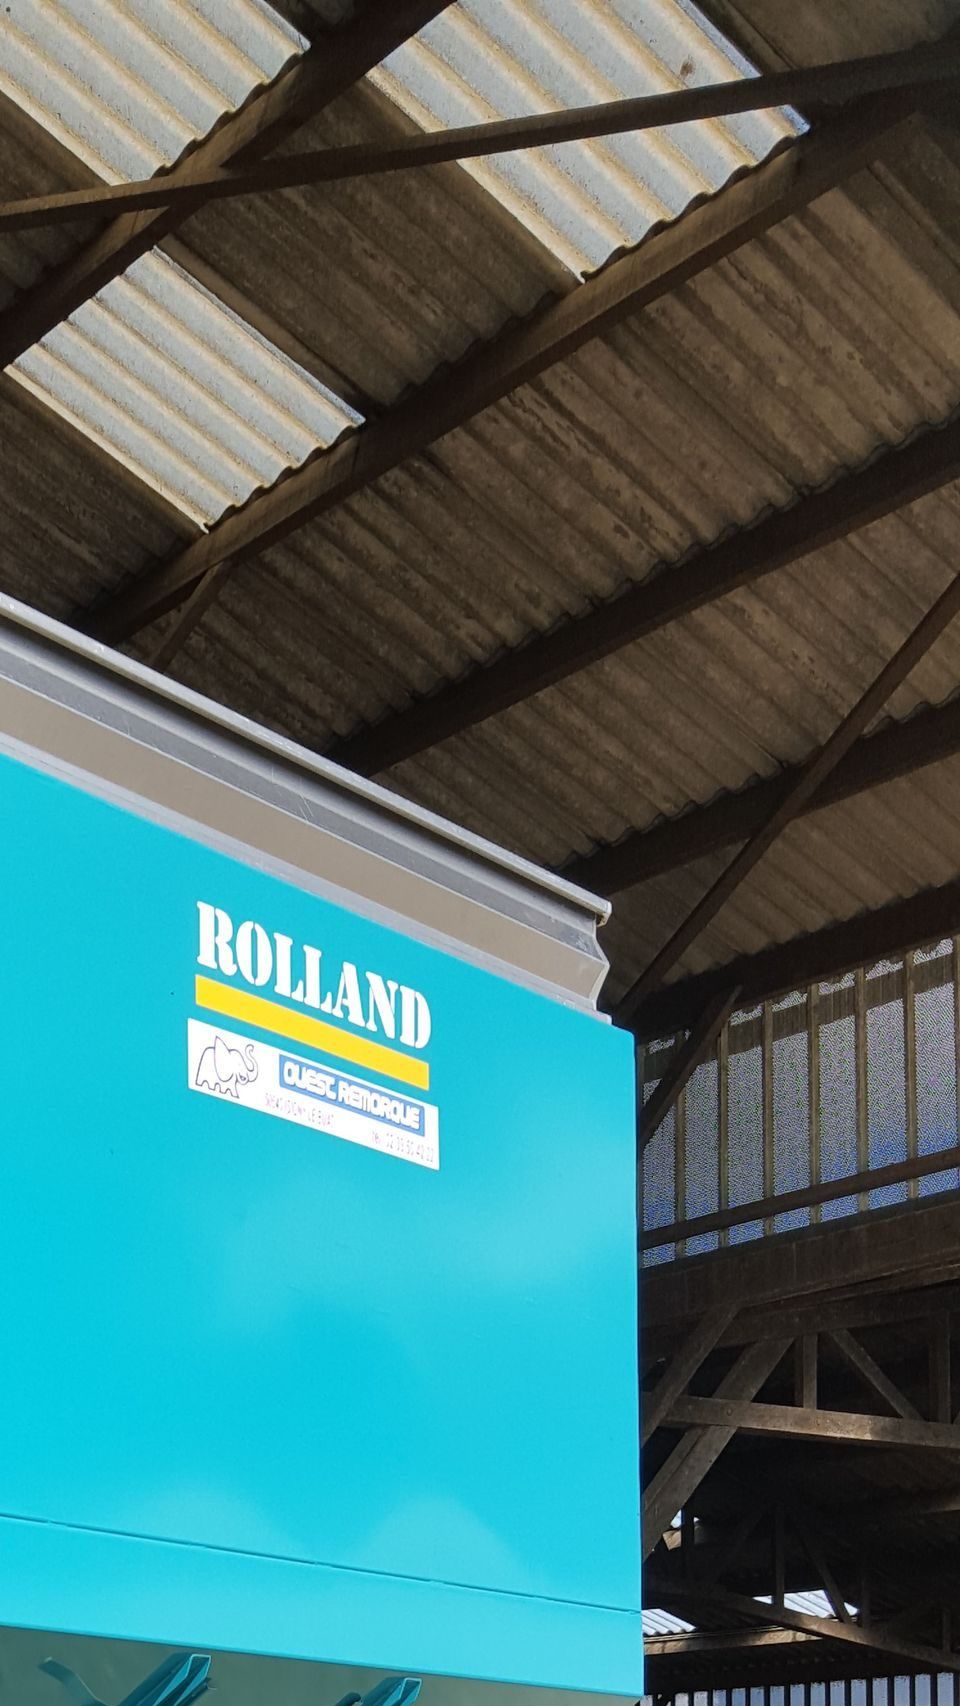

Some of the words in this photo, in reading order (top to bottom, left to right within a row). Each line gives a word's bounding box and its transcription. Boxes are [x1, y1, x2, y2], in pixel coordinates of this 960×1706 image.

[196, 900, 432, 1049] ROLLAND
[282, 1060, 337, 1100] OUEST
[337, 1079, 421, 1130] REMORQUE
